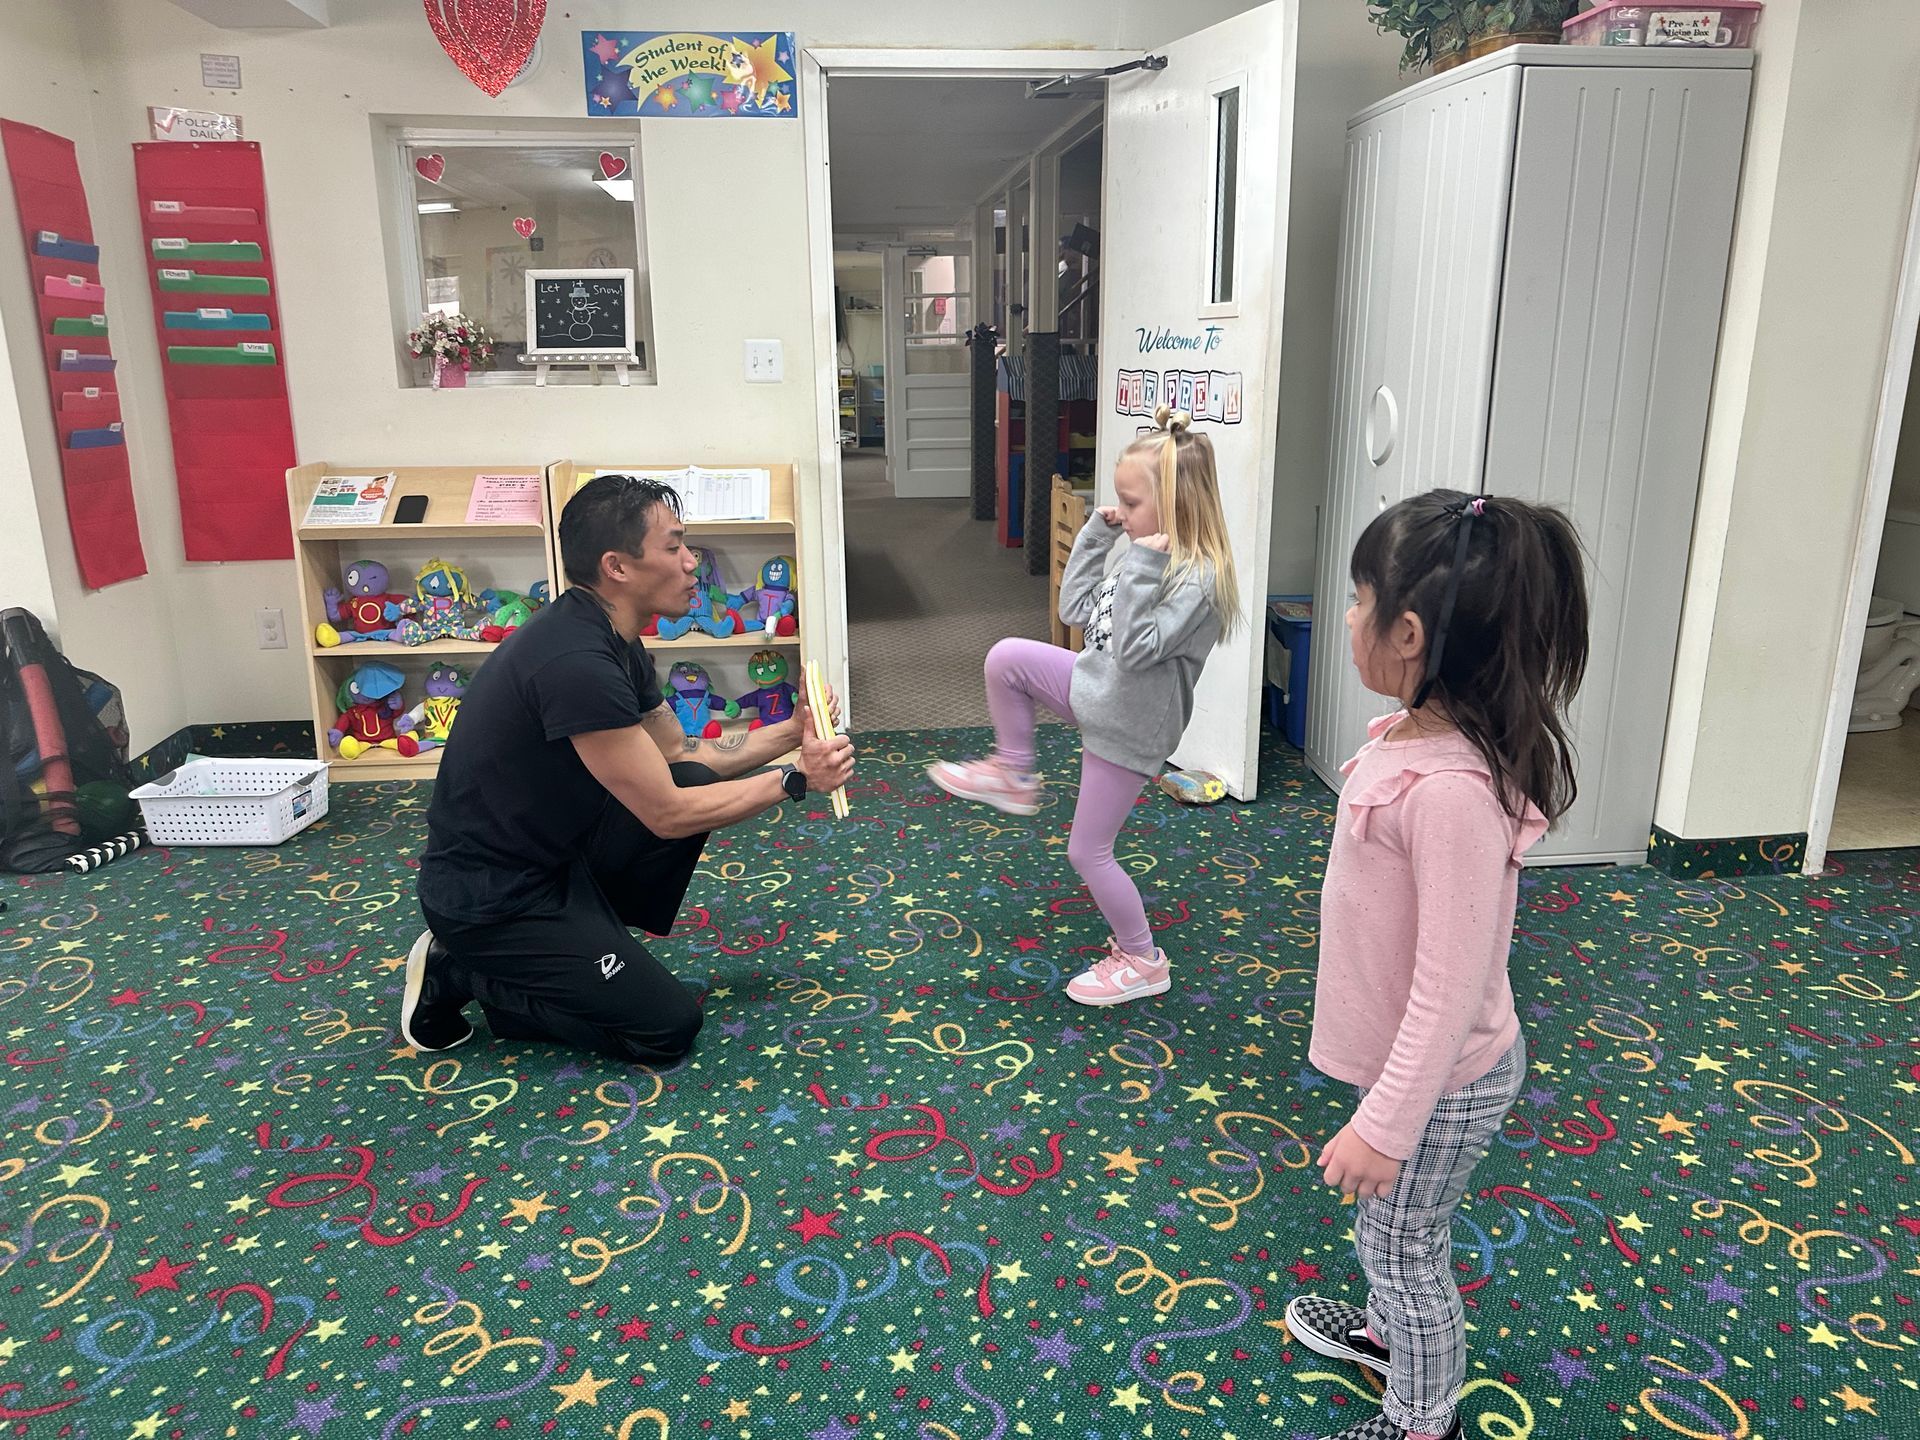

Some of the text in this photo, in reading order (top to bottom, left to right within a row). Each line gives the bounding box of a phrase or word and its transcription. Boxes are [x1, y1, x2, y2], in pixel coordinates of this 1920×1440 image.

[1668, 20, 1684, 28] Pre
[1692, 19, 1700, 28] K
[1693, 29, 1710, 37] Box
[635, 39, 728, 69] Student of
[641, 56, 727, 84] the Week!
[190, 129, 225, 140] DAILY
[540, 280, 623, 296] Let it Snow!
[1135, 326, 1225, 354] Welcome To
[1119, 376, 1156, 408] THE
[358, 602, 381, 624] O
[433, 597, 453, 620] P
[764, 594, 777, 617] T
[434, 704, 455, 727] V
[685, 698, 704, 720] Y
[766, 693, 784, 716] Z
[361, 713, 381, 738] U
